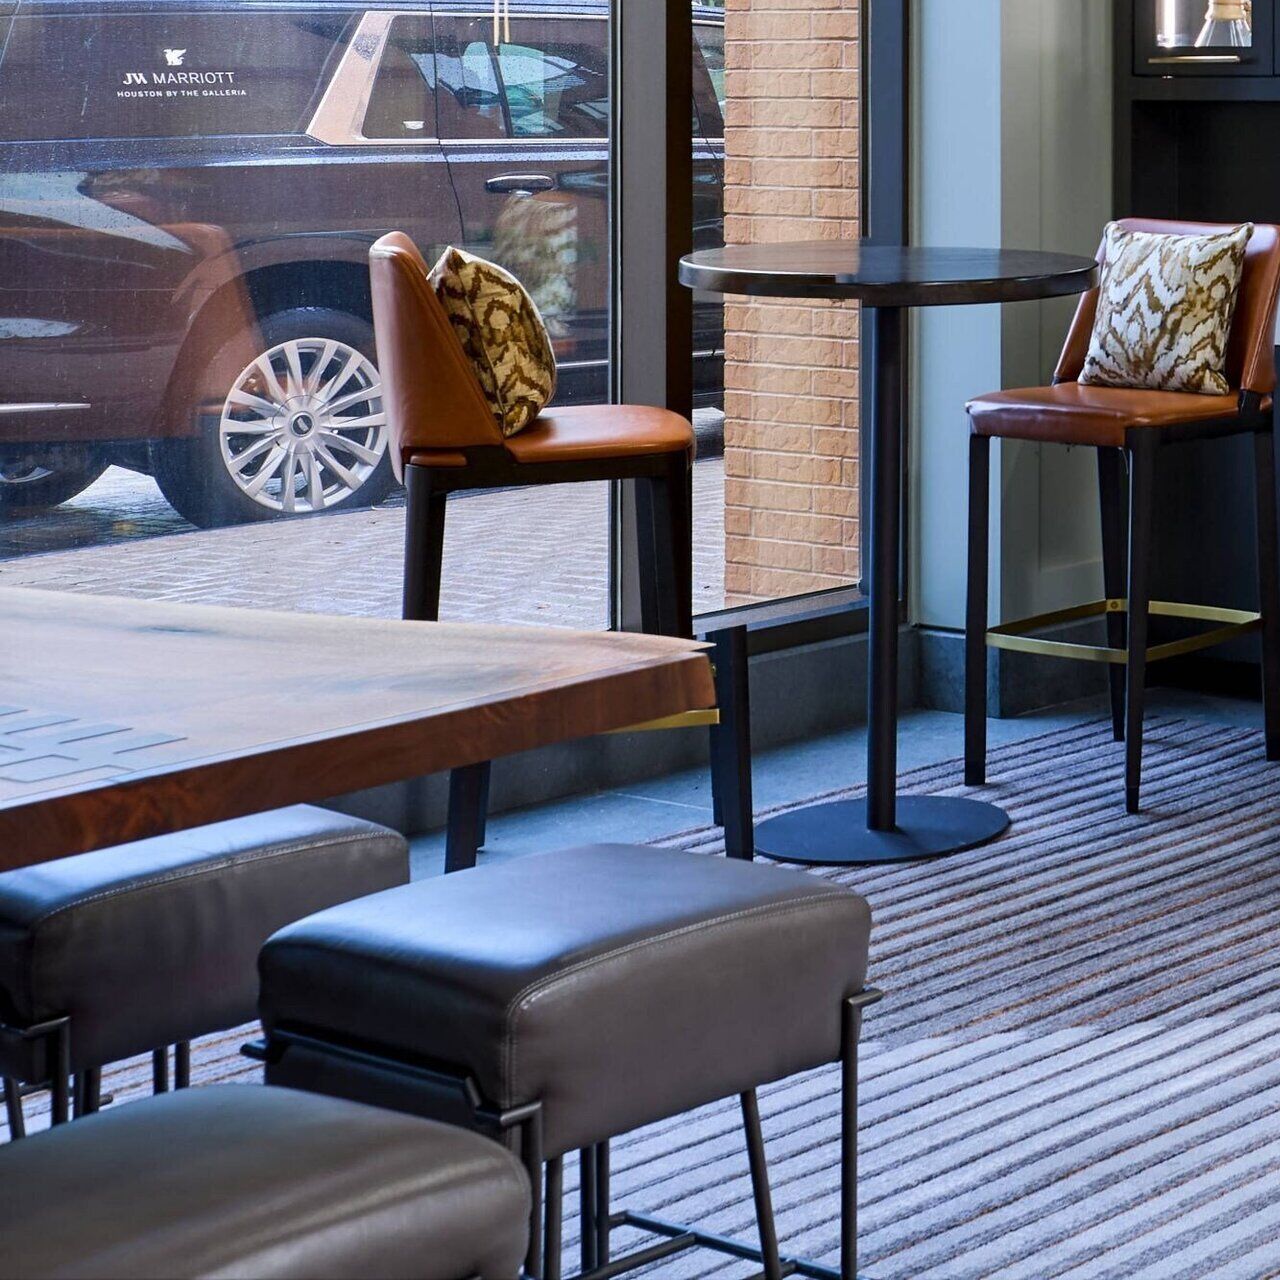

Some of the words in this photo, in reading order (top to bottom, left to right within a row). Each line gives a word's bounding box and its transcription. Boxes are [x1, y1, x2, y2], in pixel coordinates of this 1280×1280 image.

[152, 72, 235, 84] MARRIOTT
[117, 90, 163, 98] HOUSTON
[166, 90, 178, 98] BY
[202, 89, 247, 98] GALLERIA
